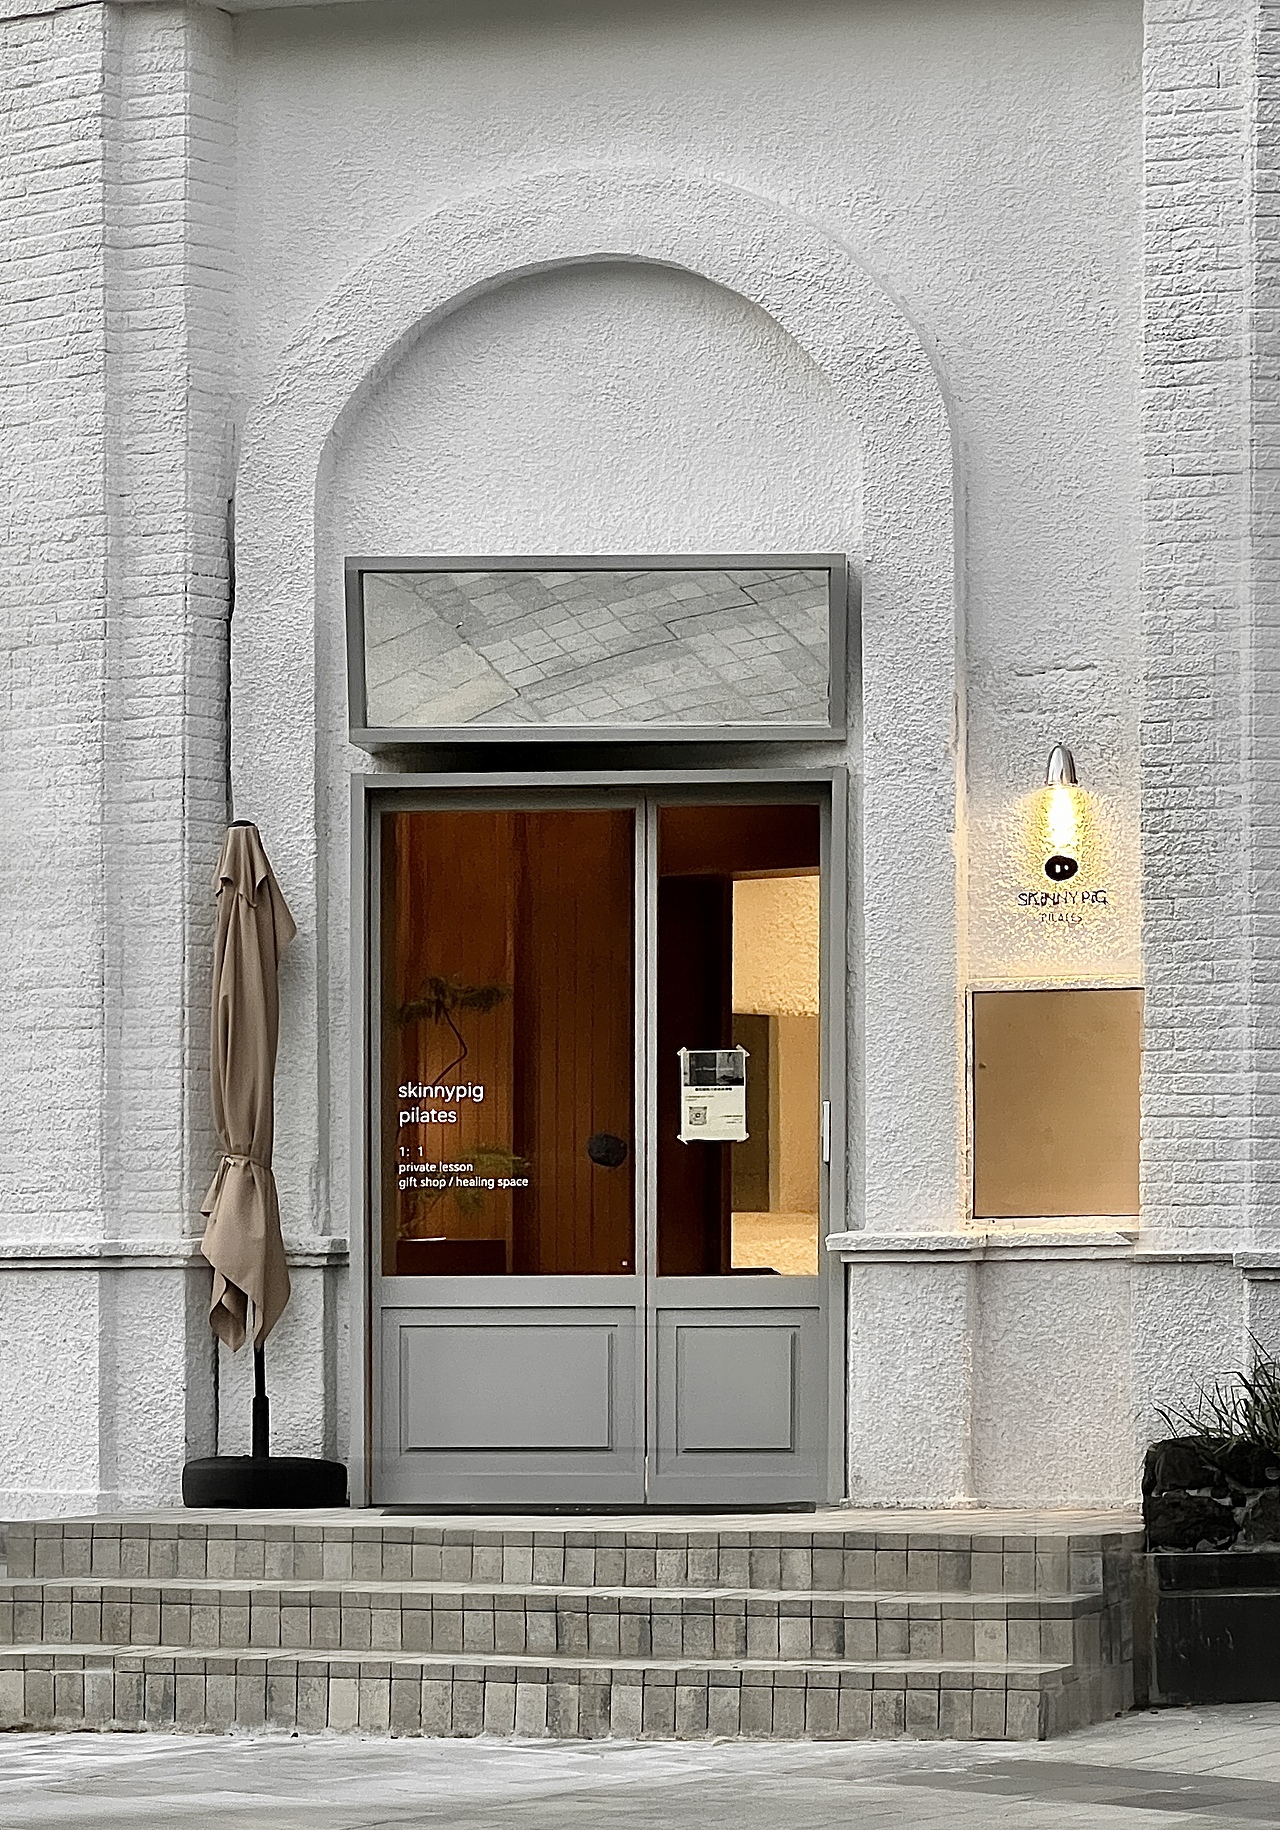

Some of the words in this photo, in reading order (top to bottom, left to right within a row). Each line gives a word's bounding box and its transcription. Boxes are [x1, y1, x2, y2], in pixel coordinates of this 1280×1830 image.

[398, 1082, 484, 1102] skinnypig
[399, 1107, 457, 1127] pilates
[399, 1162, 436, 1174] private
[439, 1162, 473, 1172] lesson
[399, 1177, 417, 1189] gift
[420, 1177, 446, 1189] shop
[455, 1177, 494, 1189] healing
[497, 1178, 529, 1189] space
